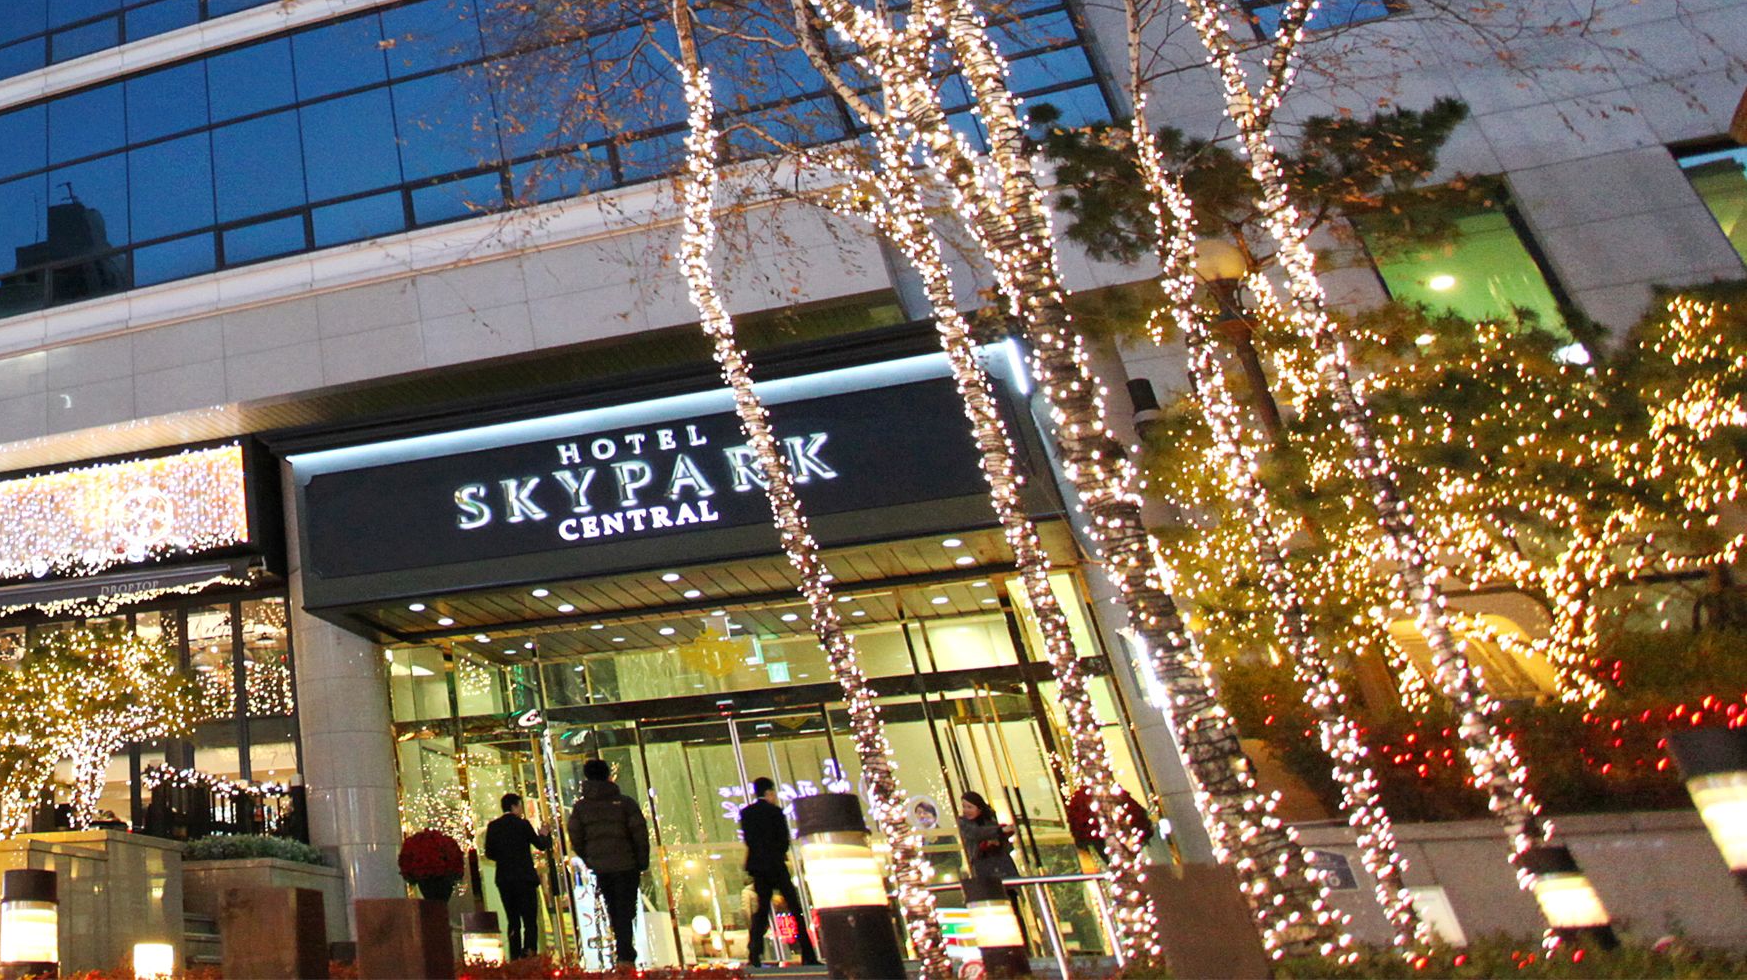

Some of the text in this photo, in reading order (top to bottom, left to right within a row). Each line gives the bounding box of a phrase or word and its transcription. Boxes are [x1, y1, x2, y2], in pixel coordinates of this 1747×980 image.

[556, 424, 707, 465] HOTEL
[453, 431, 839, 530] SKYPARK
[558, 500, 719, 541] CENTRAL
[100, 580, 159, 595] DROPTOP
